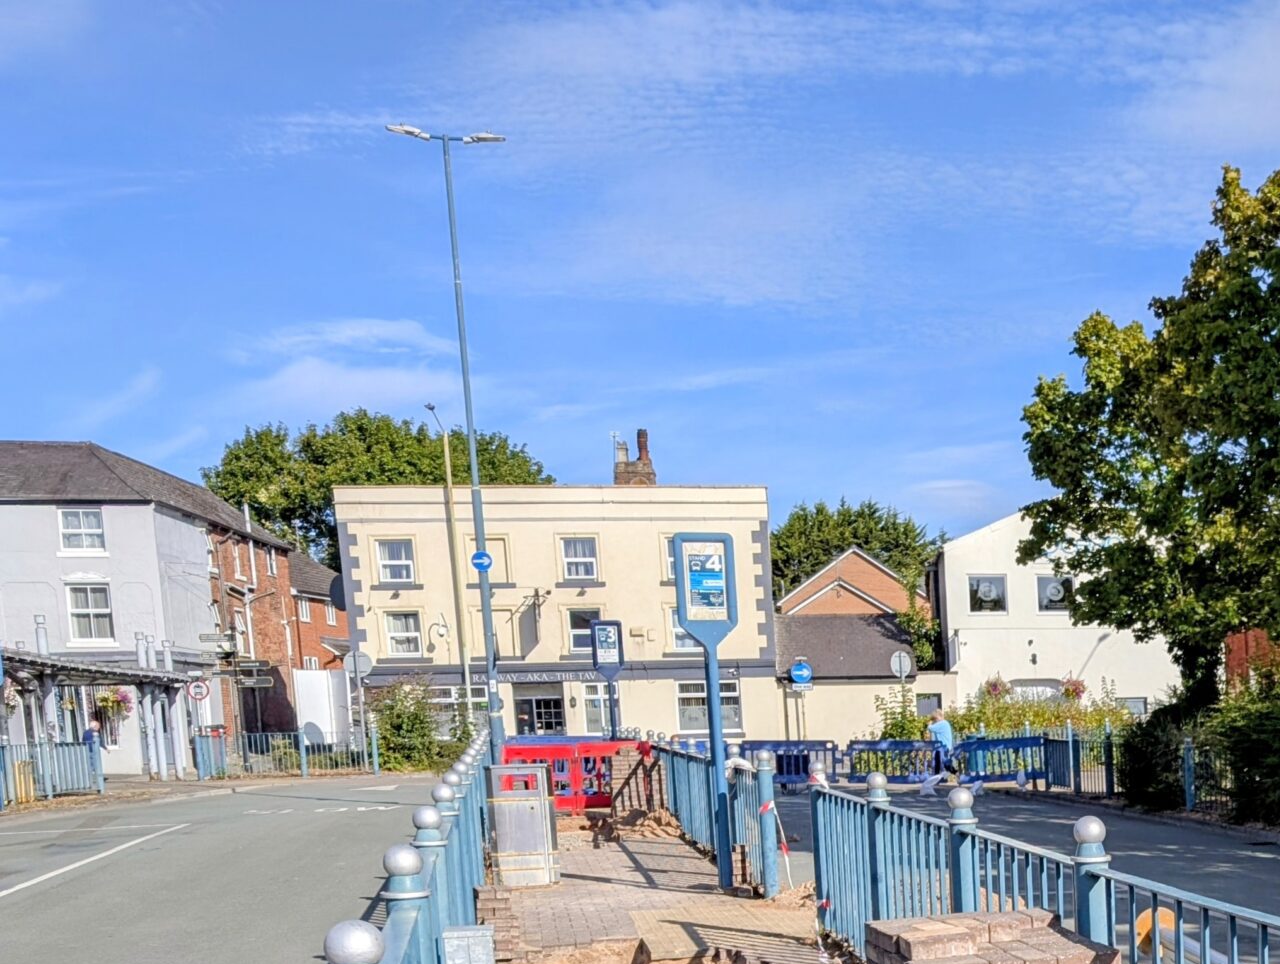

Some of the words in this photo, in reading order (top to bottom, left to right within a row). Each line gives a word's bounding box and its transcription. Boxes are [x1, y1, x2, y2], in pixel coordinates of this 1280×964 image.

[704, 554, 722, 572] 4
[607, 628, 616, 643] 3
[472, 673, 518, 683] RAWAY
[526, 673, 548, 682] AKA
[556, 672, 575, 681] THE
[579, 672, 597, 680] TAV
